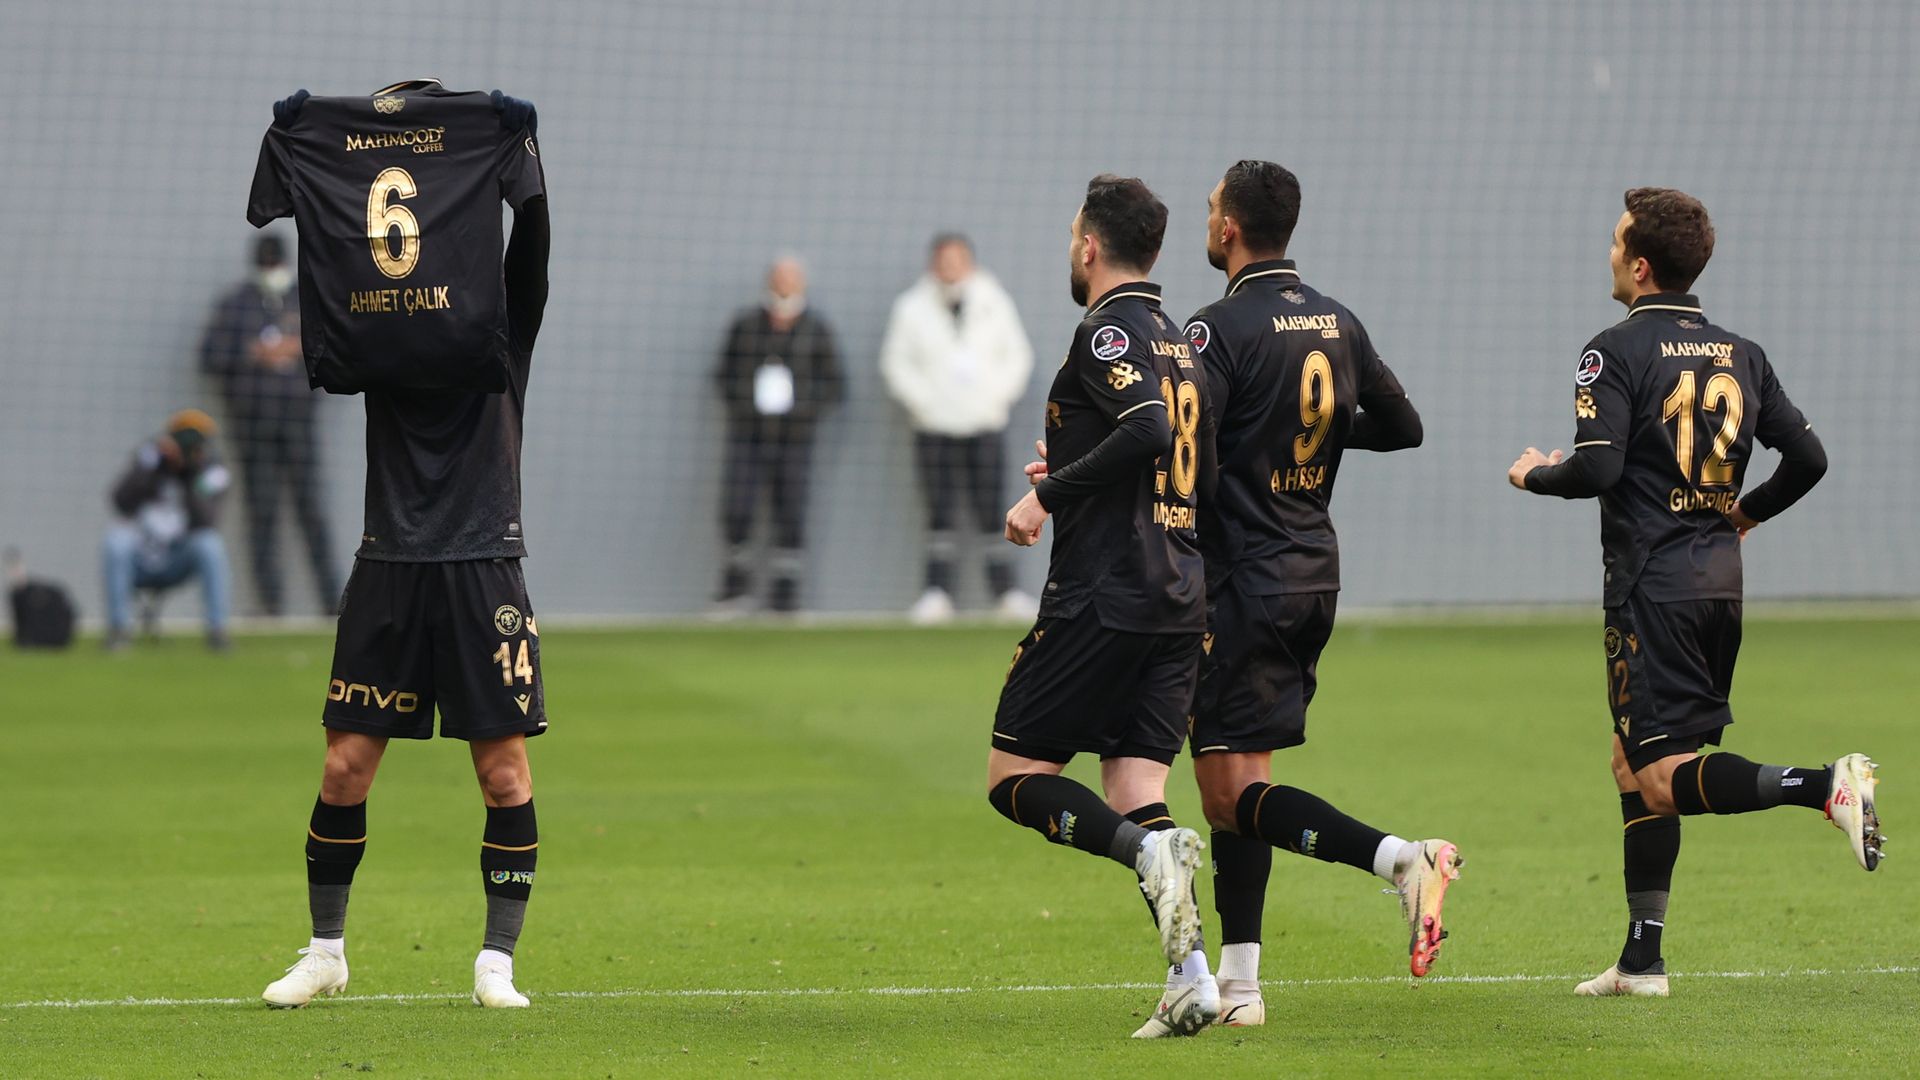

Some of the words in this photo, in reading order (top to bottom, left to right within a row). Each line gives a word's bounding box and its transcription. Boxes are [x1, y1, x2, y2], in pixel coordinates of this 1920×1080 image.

[346, 128, 441, 151] MAHMOOD
[412, 143, 444, 154] COFFEE
[366, 166, 421, 279] 6
[350, 289, 400, 313] AHMET
[1272, 315, 1337, 332] MAHMOOD
[1660, 341, 1730, 358] MAHMOOD
[1293, 350, 1335, 465] 9
[1662, 370, 1744, 487] 12
[493, 639, 533, 687] 14
